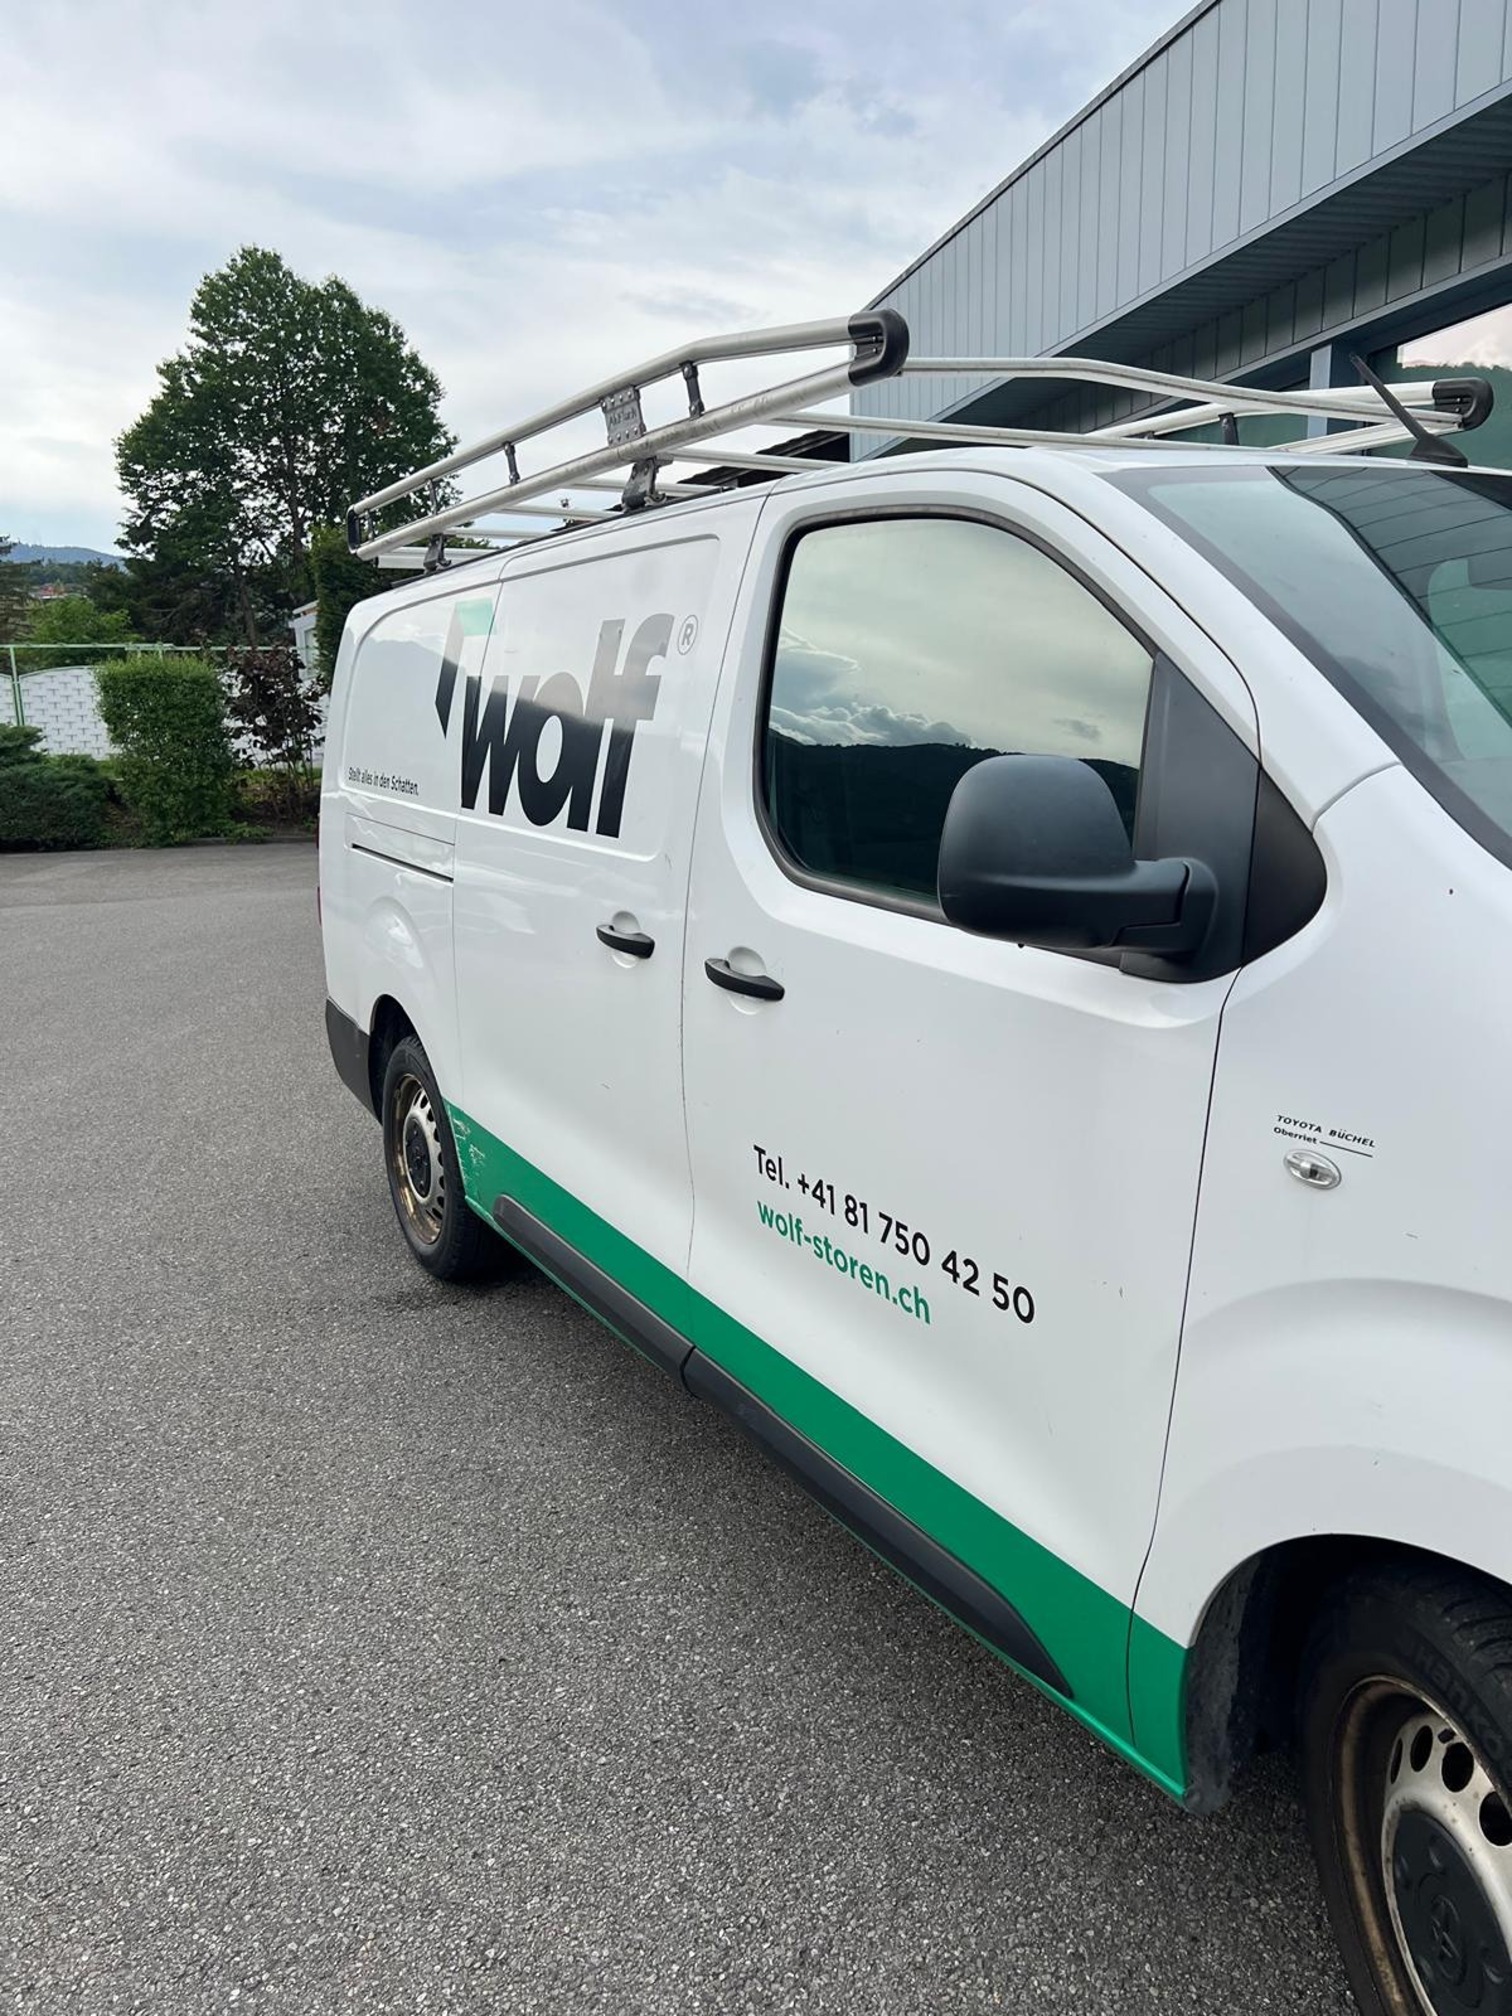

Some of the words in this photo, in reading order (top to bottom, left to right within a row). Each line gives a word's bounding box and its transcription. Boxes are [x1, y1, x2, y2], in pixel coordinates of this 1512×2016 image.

[461, 613, 674, 838] wolf
[379, 772, 390, 788] den
[1273, 1126, 1317, 1145] Oberriet
[1276, 1114, 1322, 1134] TOYOTA
[1328, 1128, 1376, 1148] BÜCHEL
[753, 1144, 790, 1189] Tel.
[797, 1173, 835, 1215] +41
[844, 1194, 869, 1234] 81
[878, 1211, 931, 1266] 750
[941, 1250, 980, 1296] 42
[991, 1272, 1035, 1324] 50
[757, 1200, 931, 1325] wolf-storen.ch
